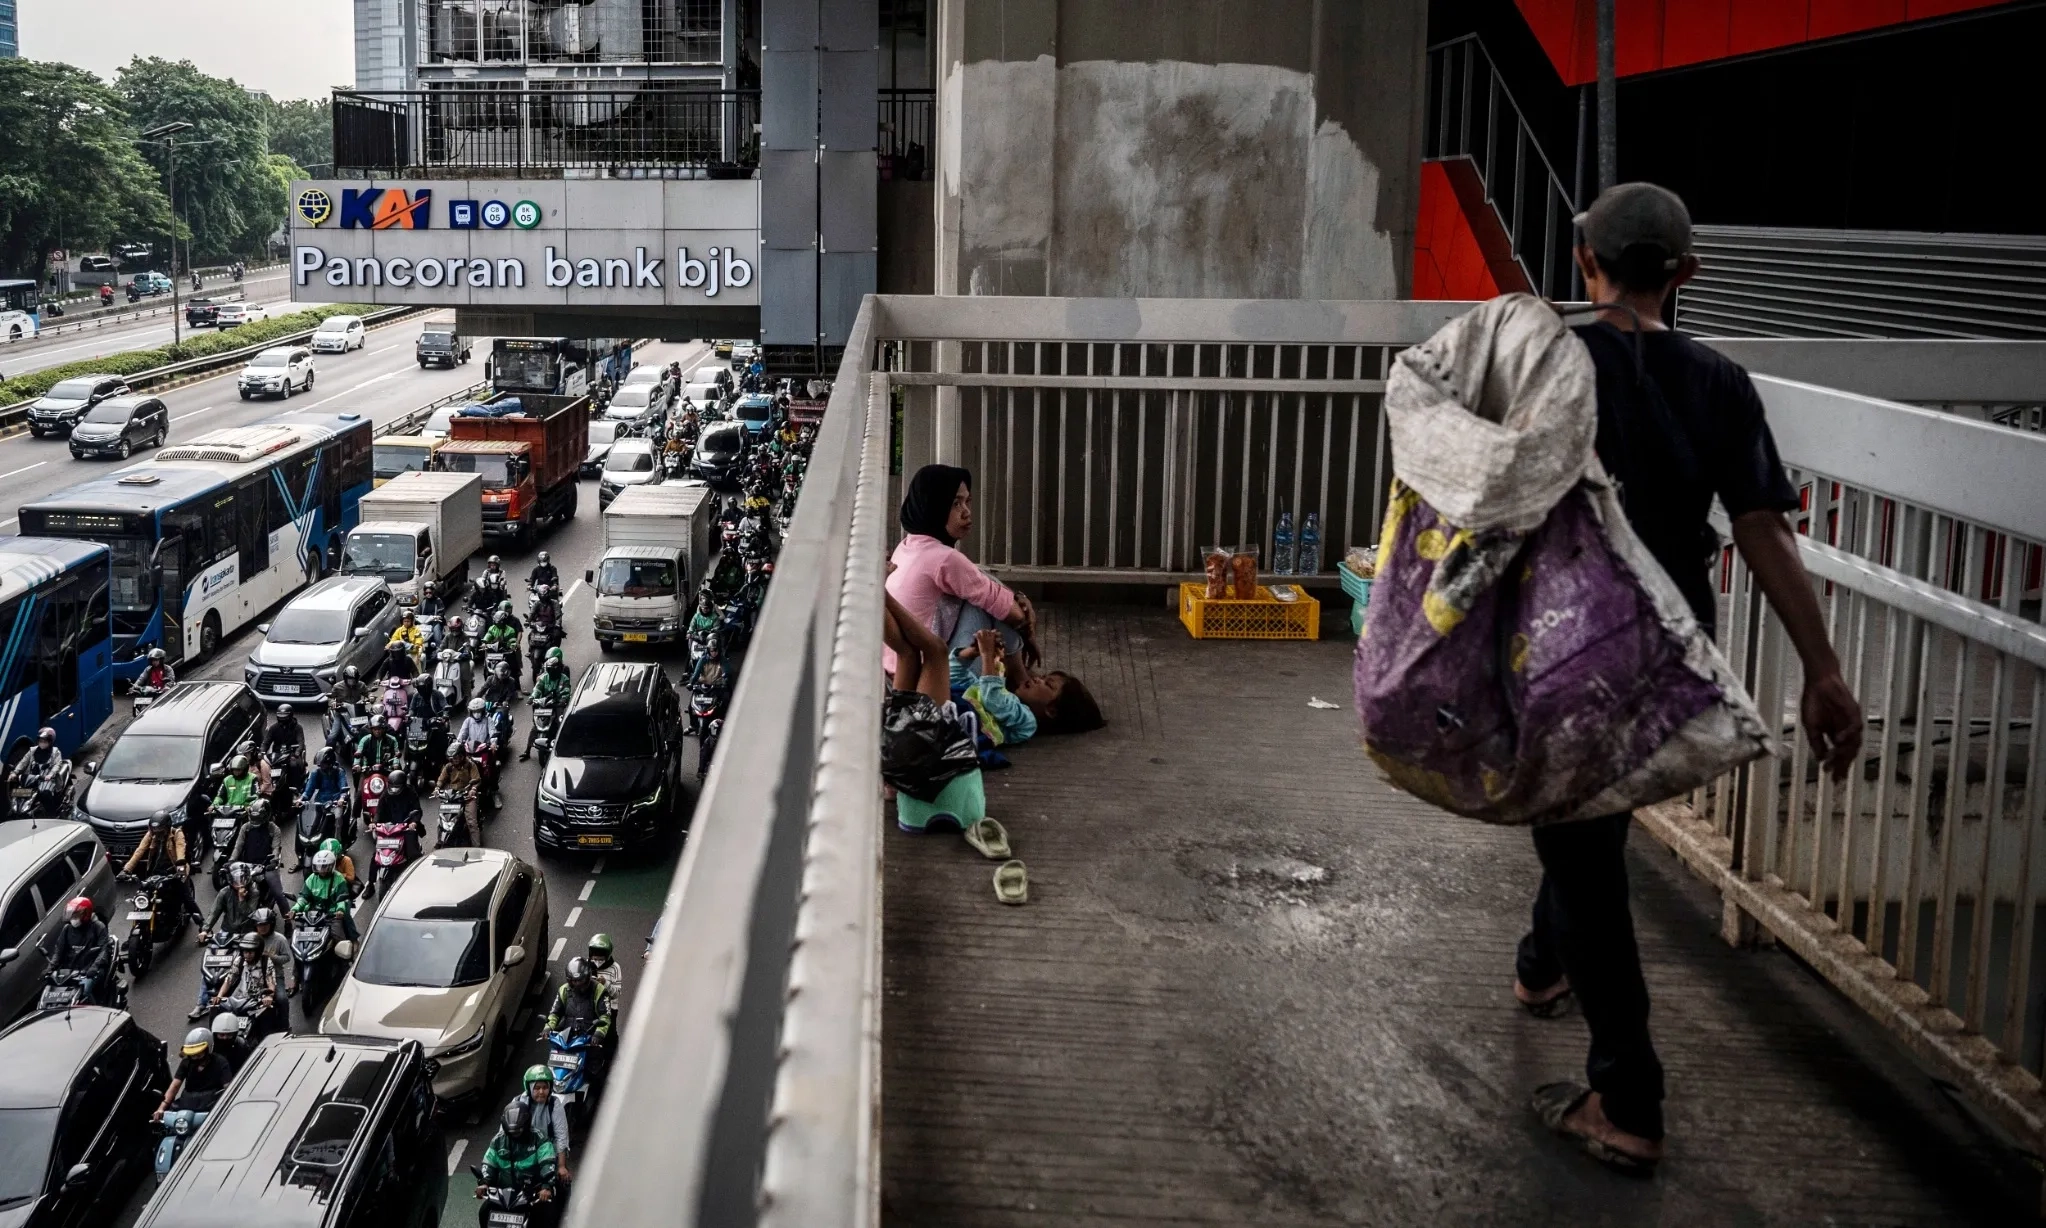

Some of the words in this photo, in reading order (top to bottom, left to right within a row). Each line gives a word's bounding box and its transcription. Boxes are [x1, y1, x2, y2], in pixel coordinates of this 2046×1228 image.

[339, 188, 432, 230] KAI
[489, 213, 501, 222] 05
[520, 213, 532, 222] 05
[295, 245, 525, 288] Pancoran
[545, 245, 666, 288] bank
[679, 245, 753, 297] bjb
